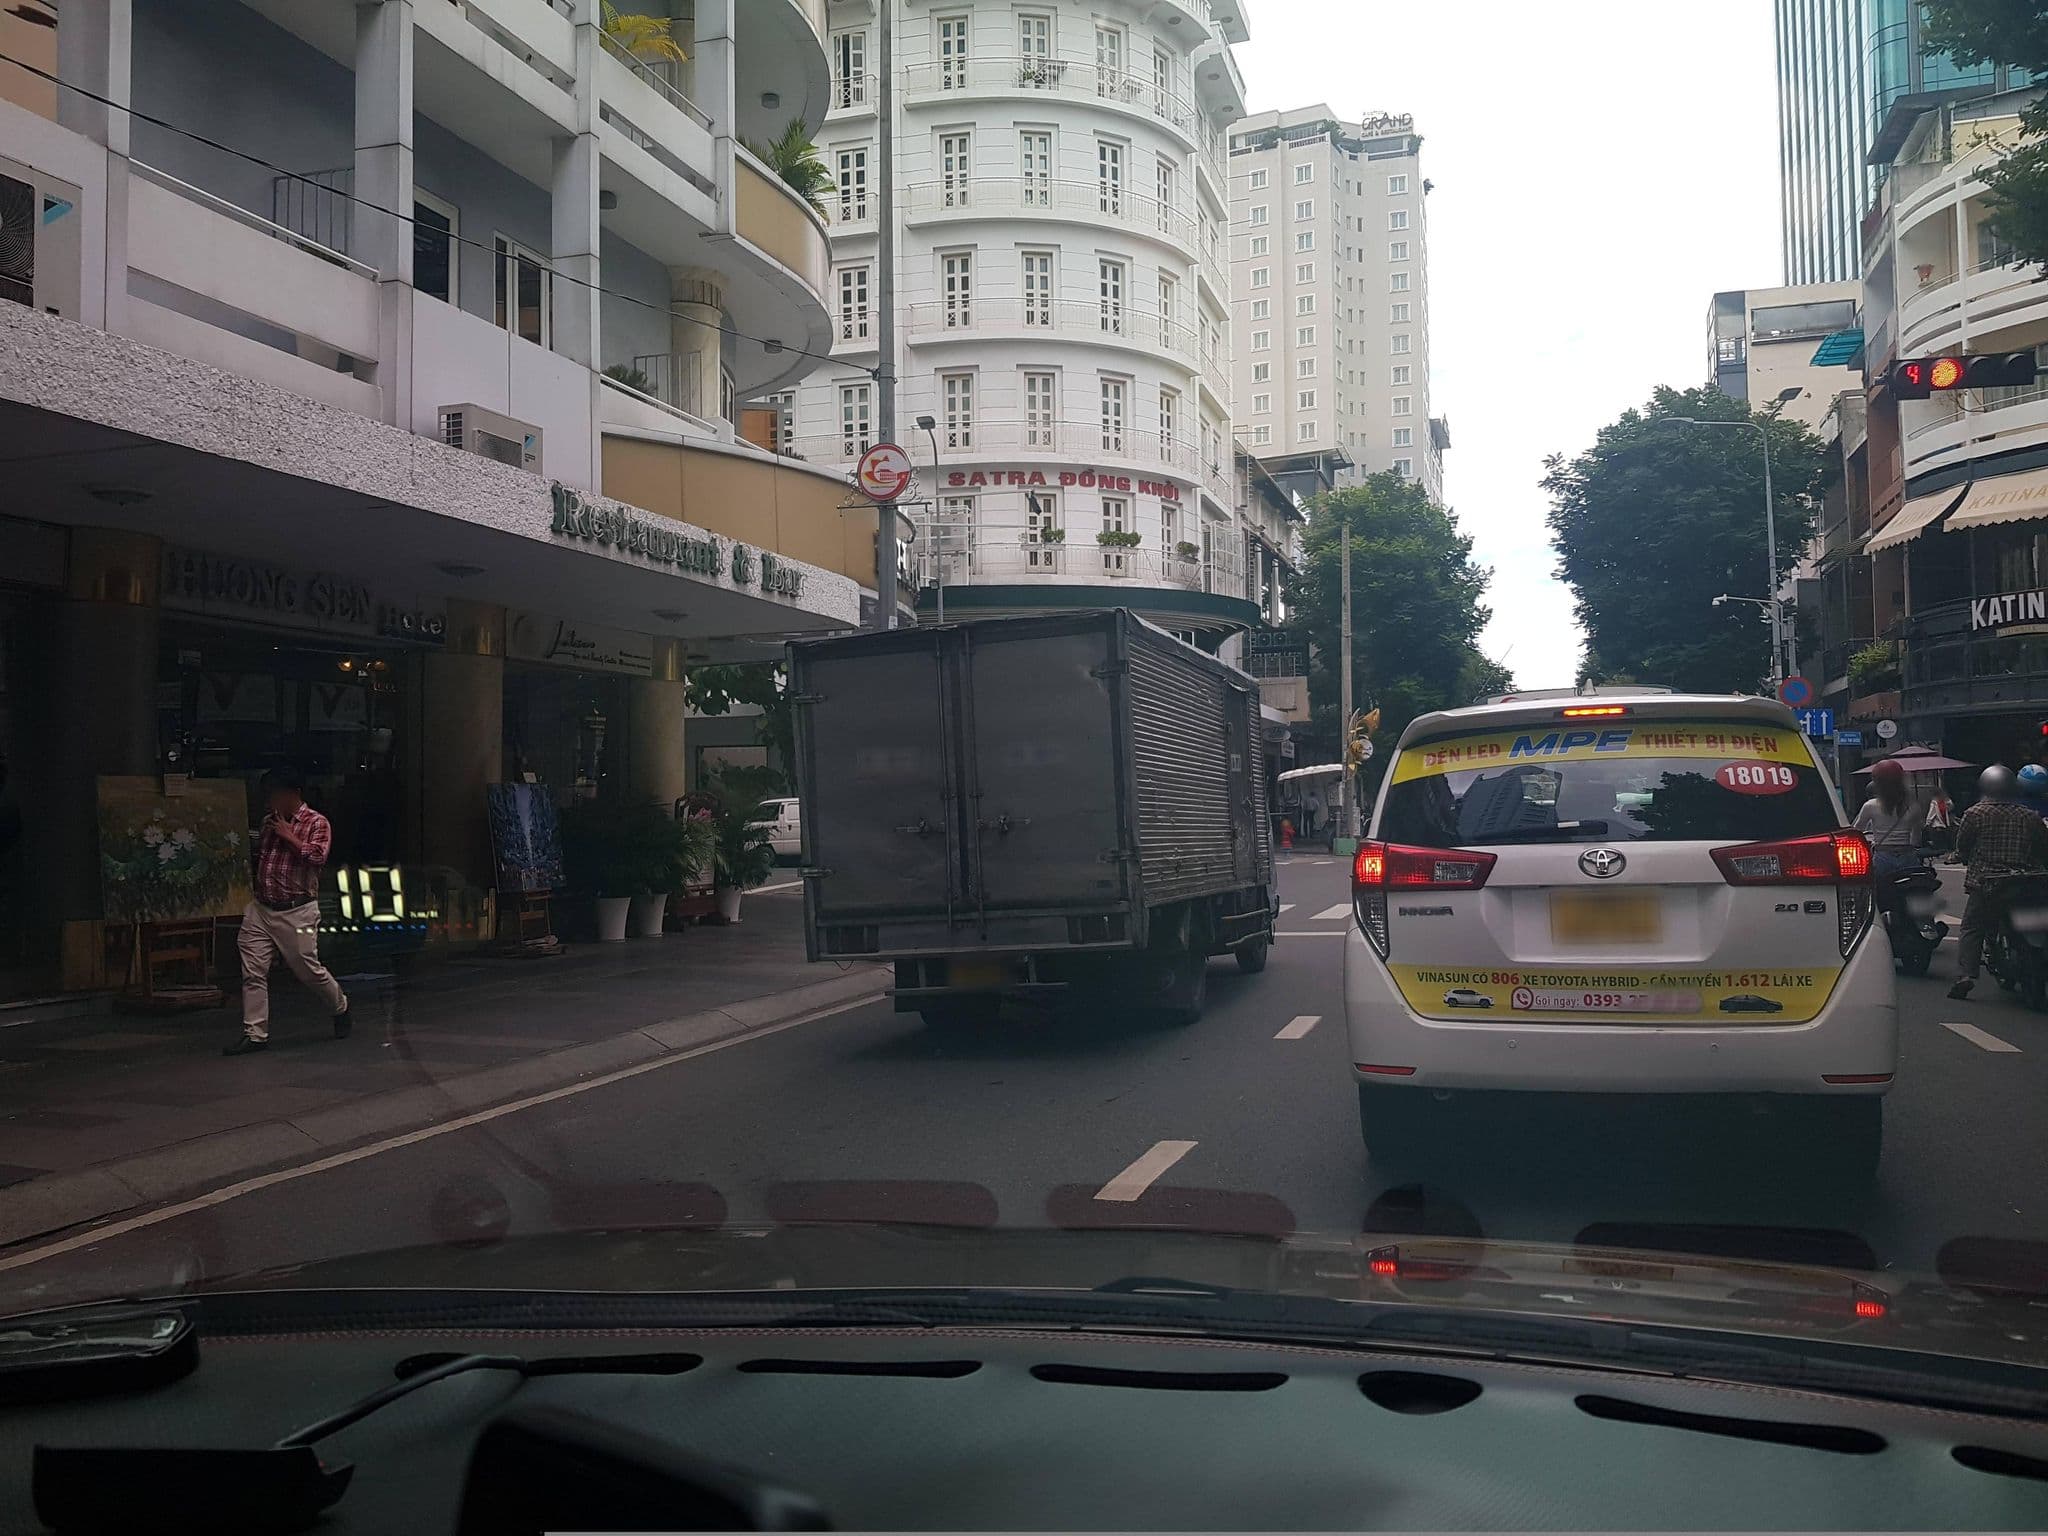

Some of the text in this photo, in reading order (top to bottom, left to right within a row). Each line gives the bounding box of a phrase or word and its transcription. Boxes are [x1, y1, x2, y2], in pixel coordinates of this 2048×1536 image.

[1362, 112, 1412, 130] GRAND
[1907, 366, 1919, 384] 4
[948, 471, 1047, 486] SATRA
[551, 481, 807, 598] Restaurant & Bar
[1466, 743, 1500, 760] LED
[1507, 729, 1630, 760] MPE
[1417, 971, 1470, 984] VINASUN
[1491, 973, 1520, 985] 806
[1522, 974, 1539, 986] XE
[1540, 974, 1589, 987] TOYOTA
[1592, 974, 1640, 987] HYBRID
[1724, 974, 1770, 987] 1.612
[1797, 975, 1813, 987] XE
